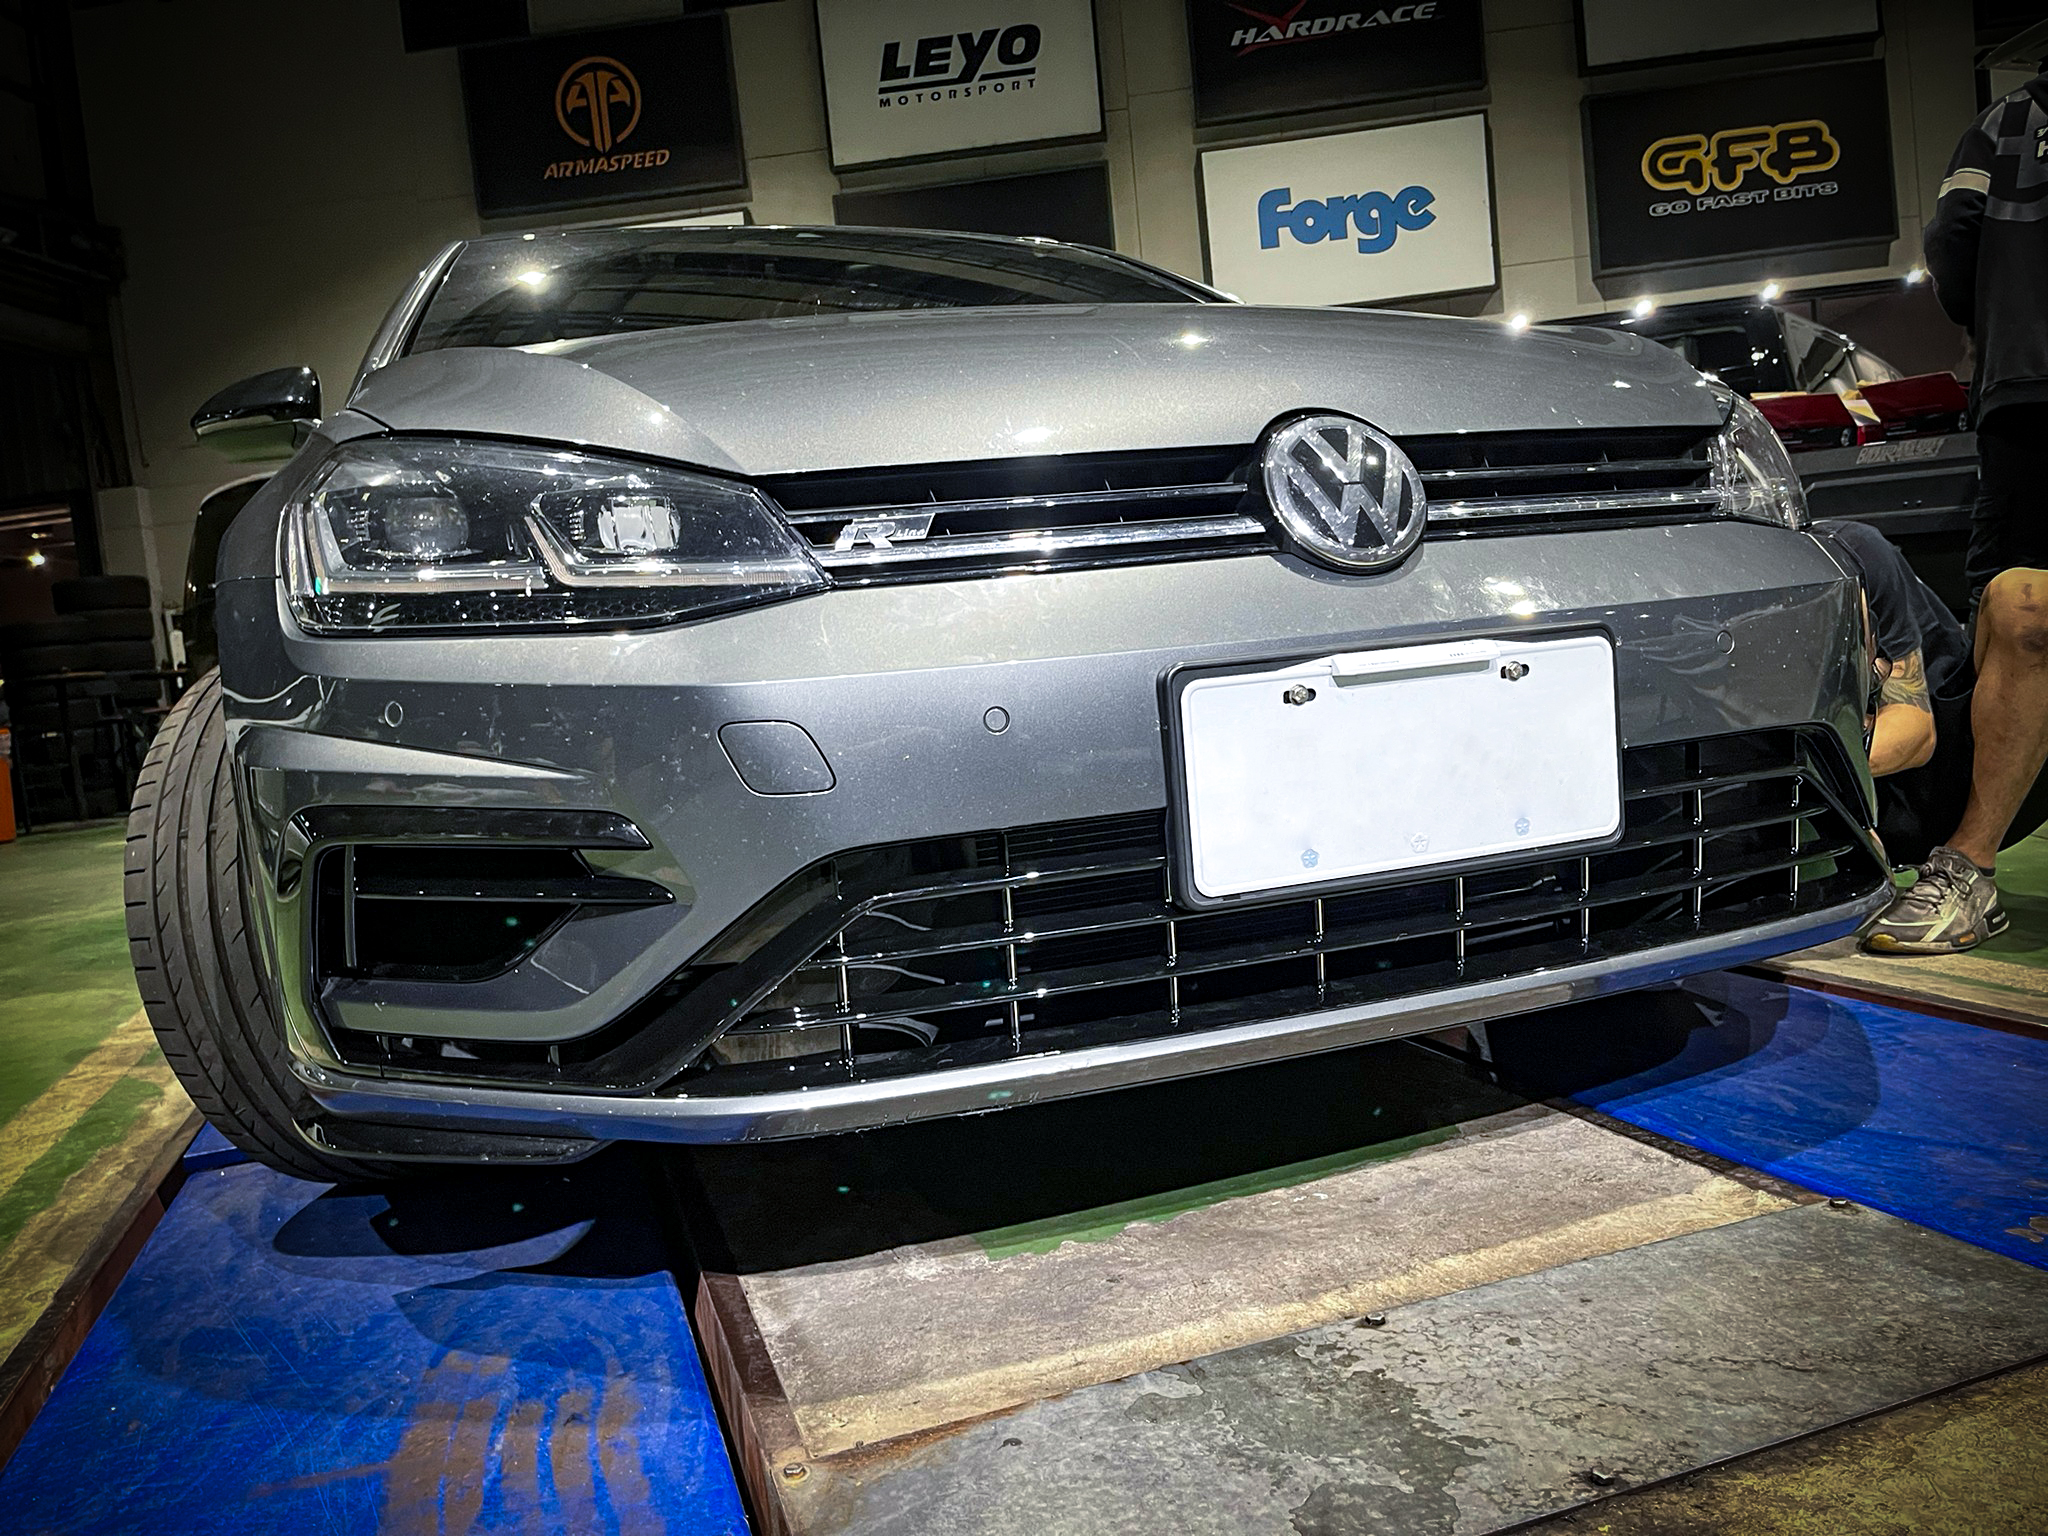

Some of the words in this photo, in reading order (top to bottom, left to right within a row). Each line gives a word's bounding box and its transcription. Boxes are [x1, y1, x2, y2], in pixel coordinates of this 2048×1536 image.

[1230, 2, 1438, 47] HARDRACE
[880, 23, 1042, 83] LEYO
[878, 78, 1036, 109] MOTORSPORT
[543, 149, 671, 180] ARMASPEED
[1641, 119, 1841, 196] GFB
[1649, 199, 1692, 217] GO
[1696, 189, 1770, 212] FAST
[1774, 181, 1839, 202] BITS
